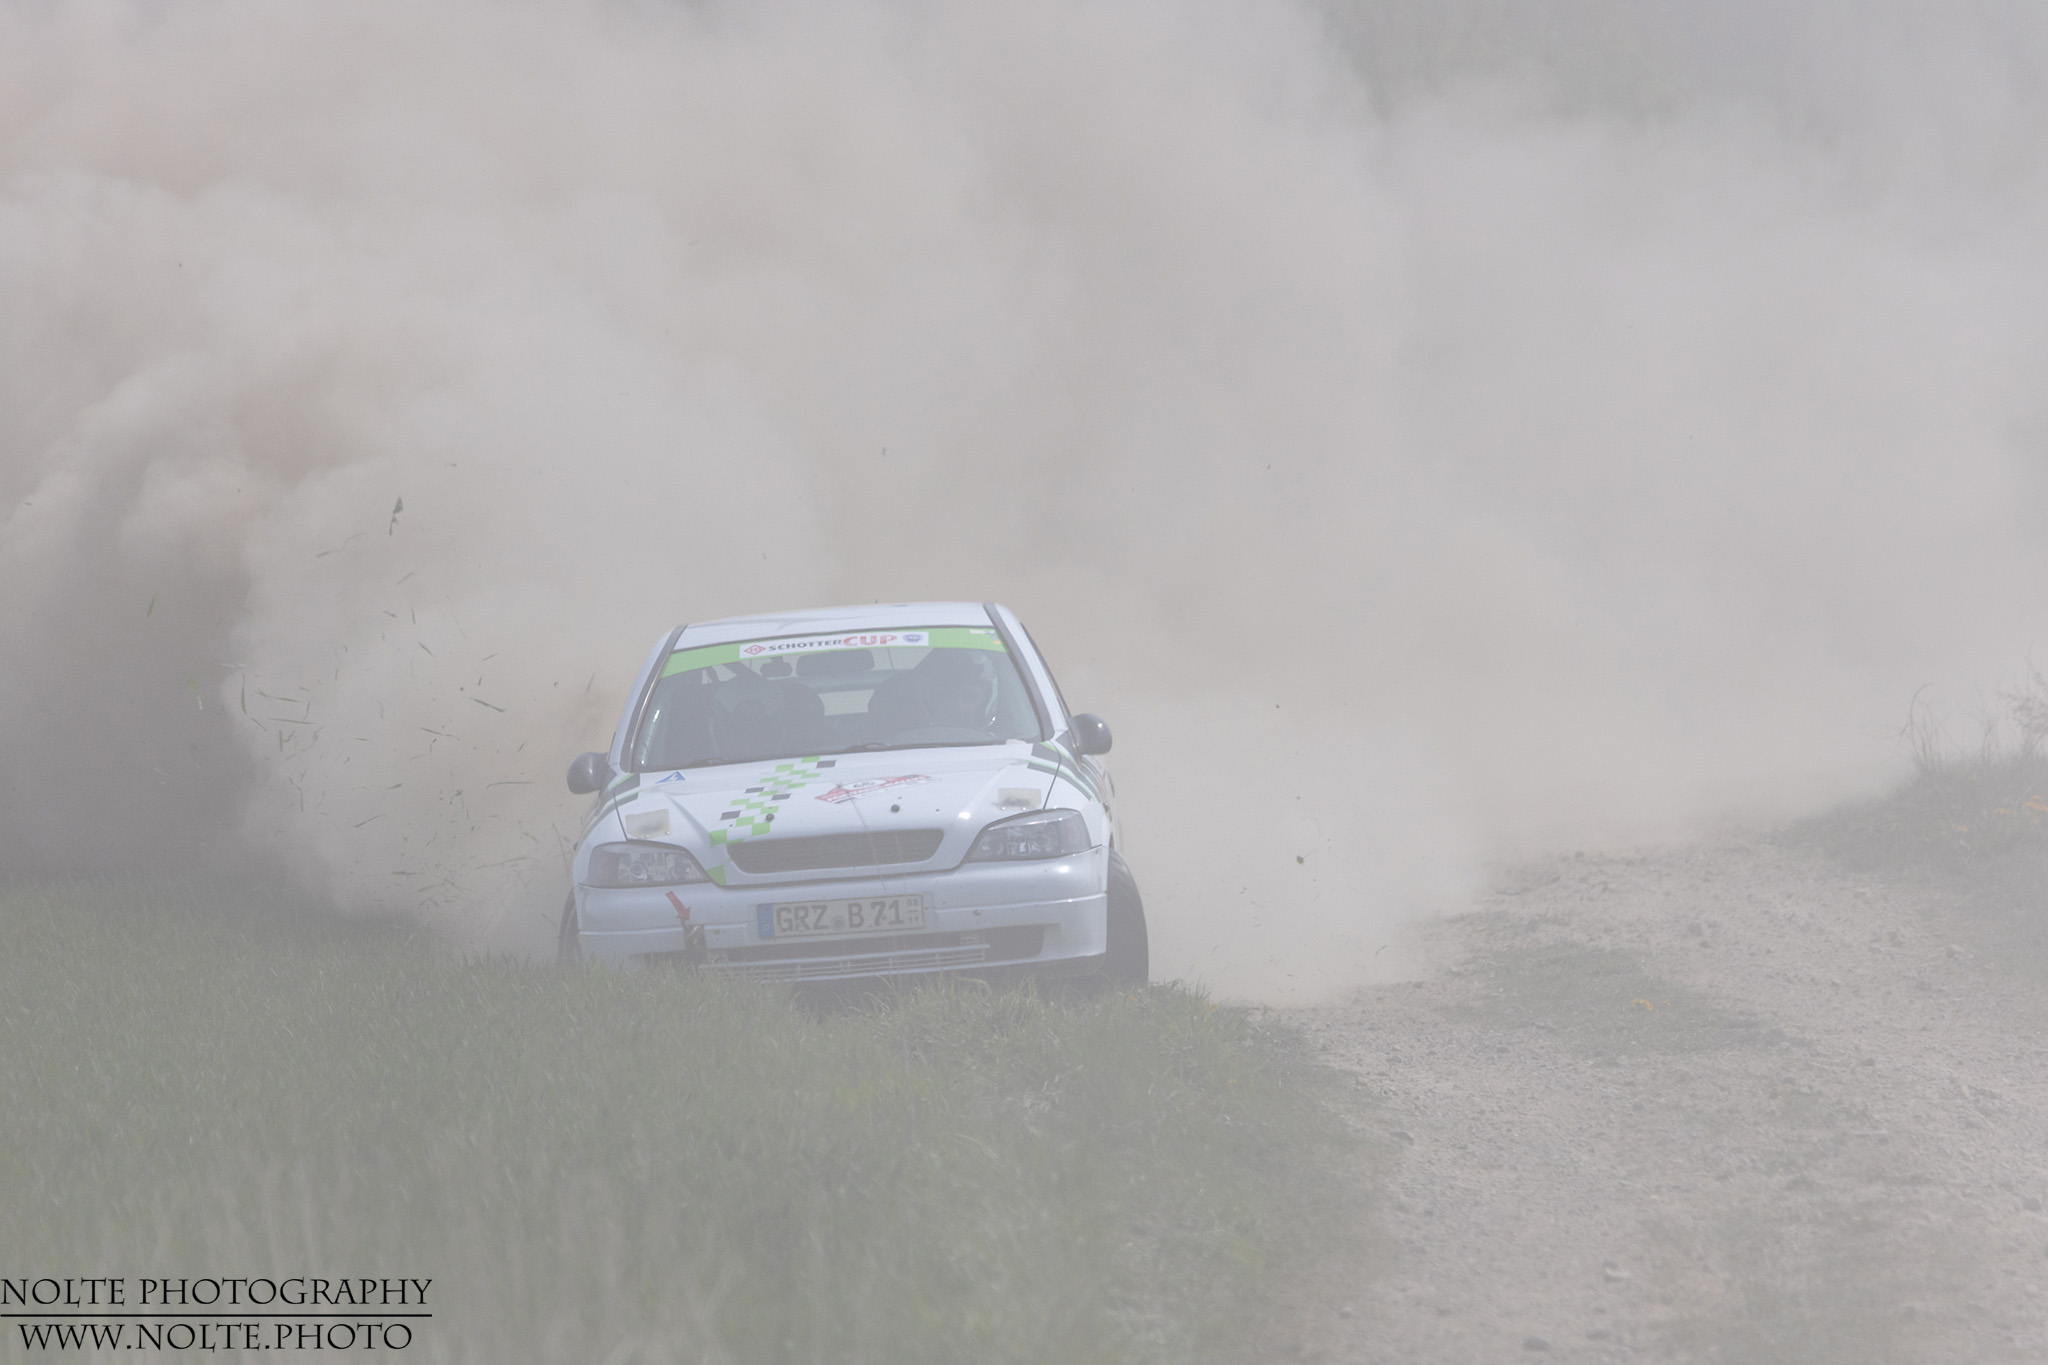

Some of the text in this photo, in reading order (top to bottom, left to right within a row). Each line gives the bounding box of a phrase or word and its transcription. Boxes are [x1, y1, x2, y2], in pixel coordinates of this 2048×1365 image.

[776, 899, 904, 932] GRZ B 71
